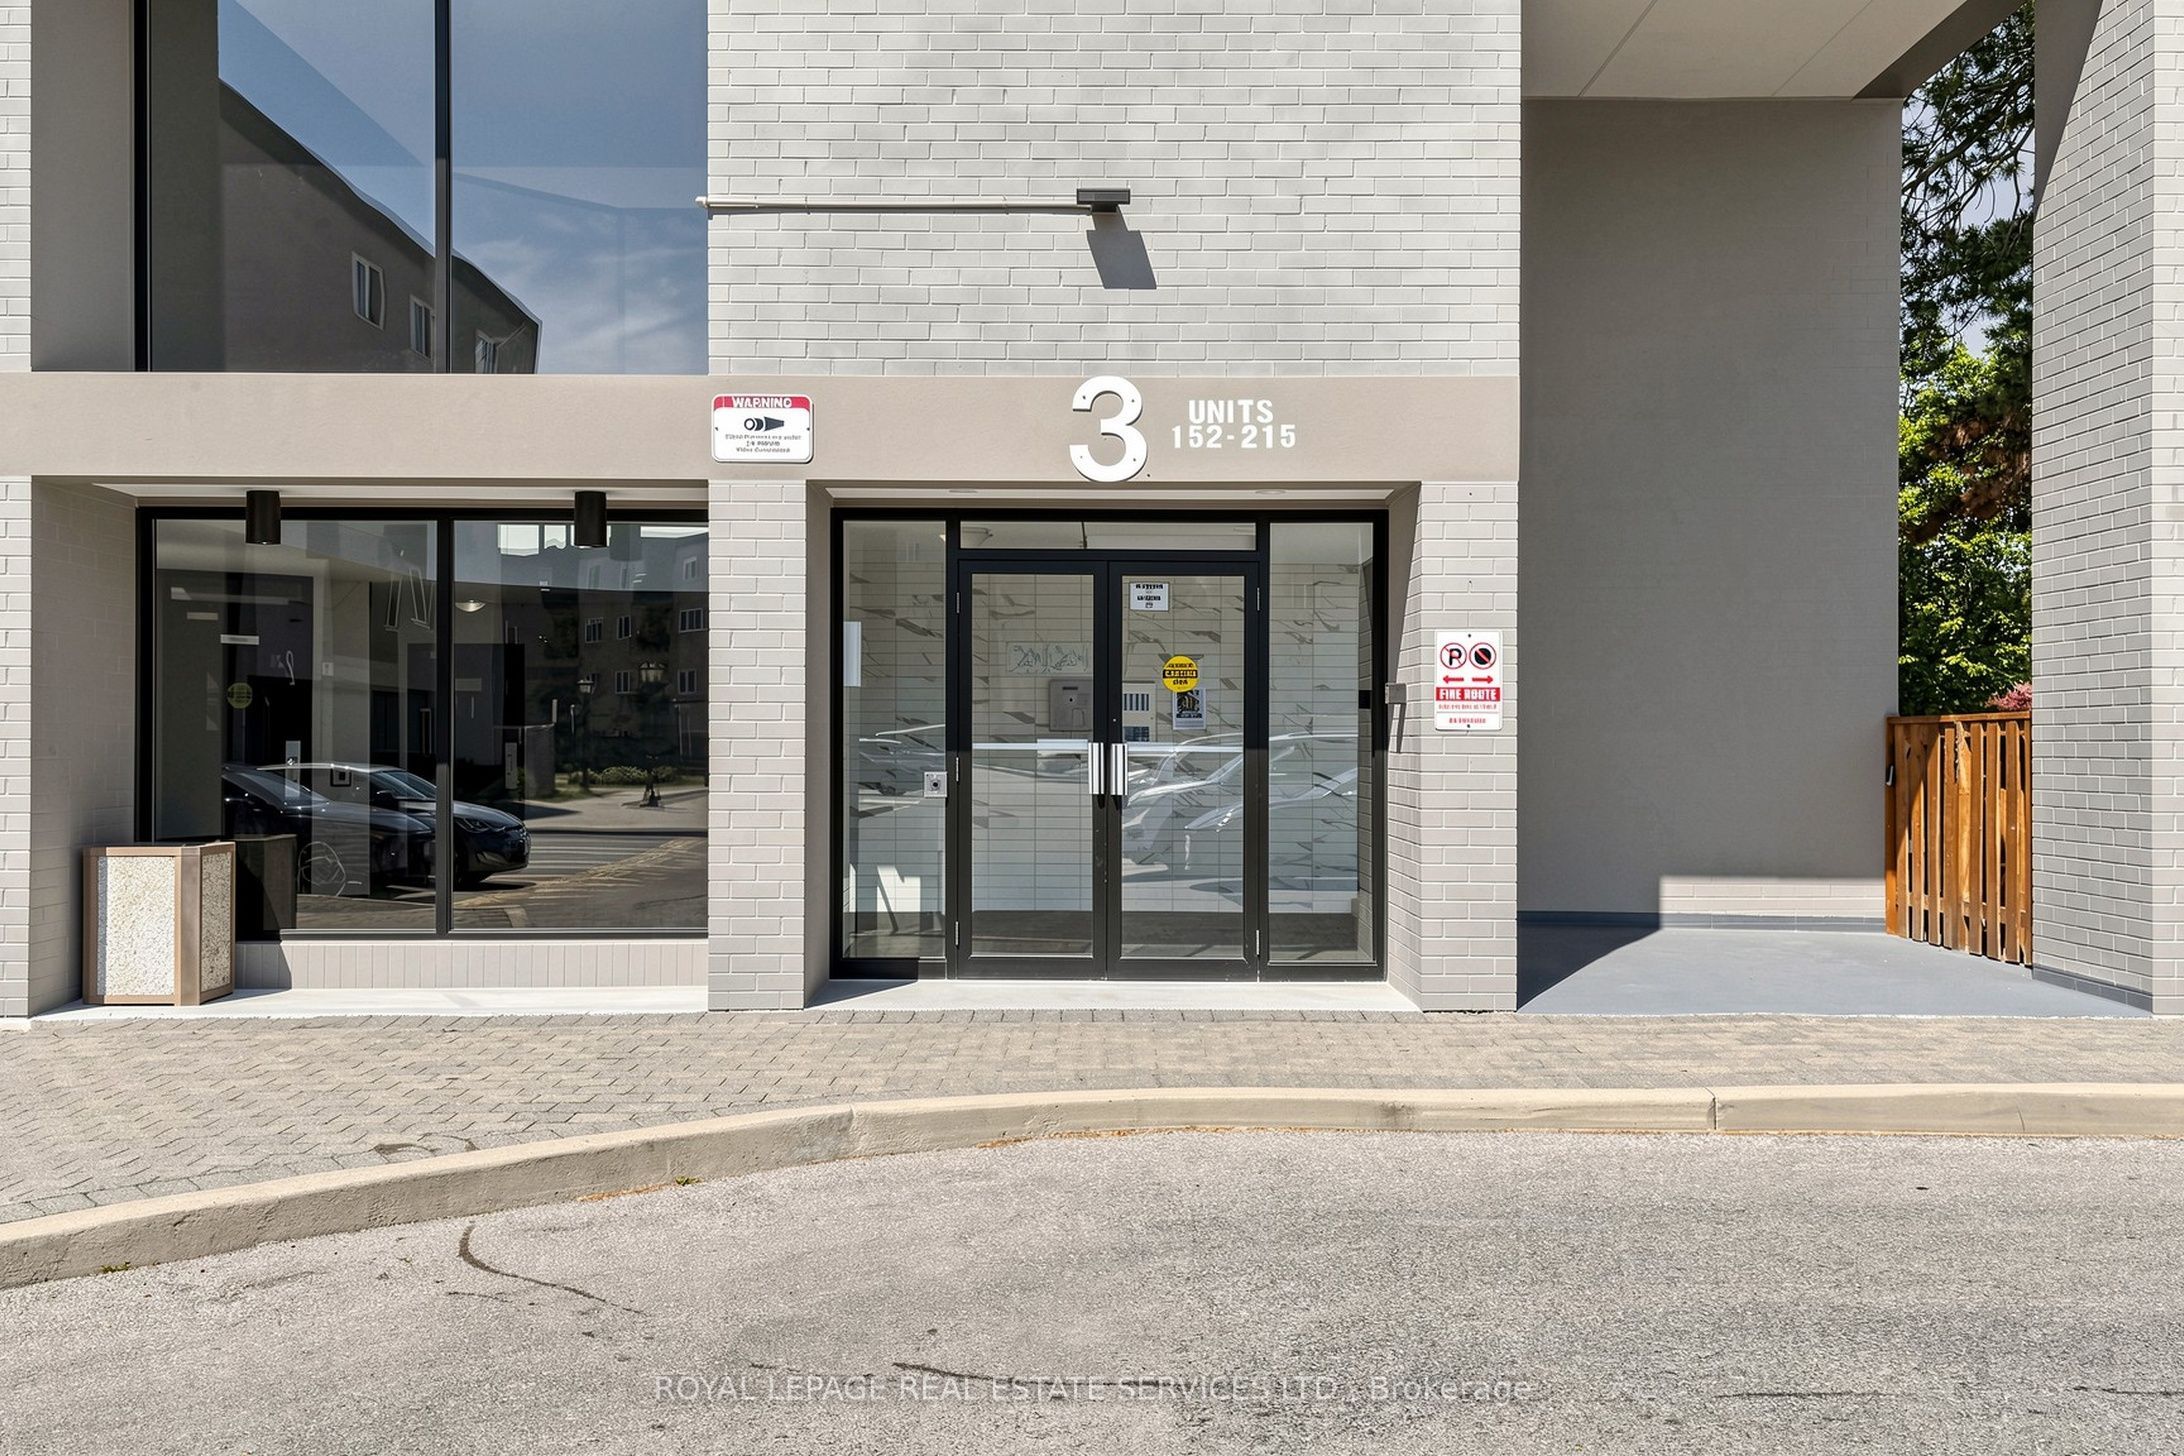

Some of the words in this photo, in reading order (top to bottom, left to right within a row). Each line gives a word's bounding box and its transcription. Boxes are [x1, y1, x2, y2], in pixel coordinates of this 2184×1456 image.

[1188, 399, 1274, 424] UNITS
[1069, 375, 1148, 482] 3
[1172, 424, 1296, 449] 152-215
